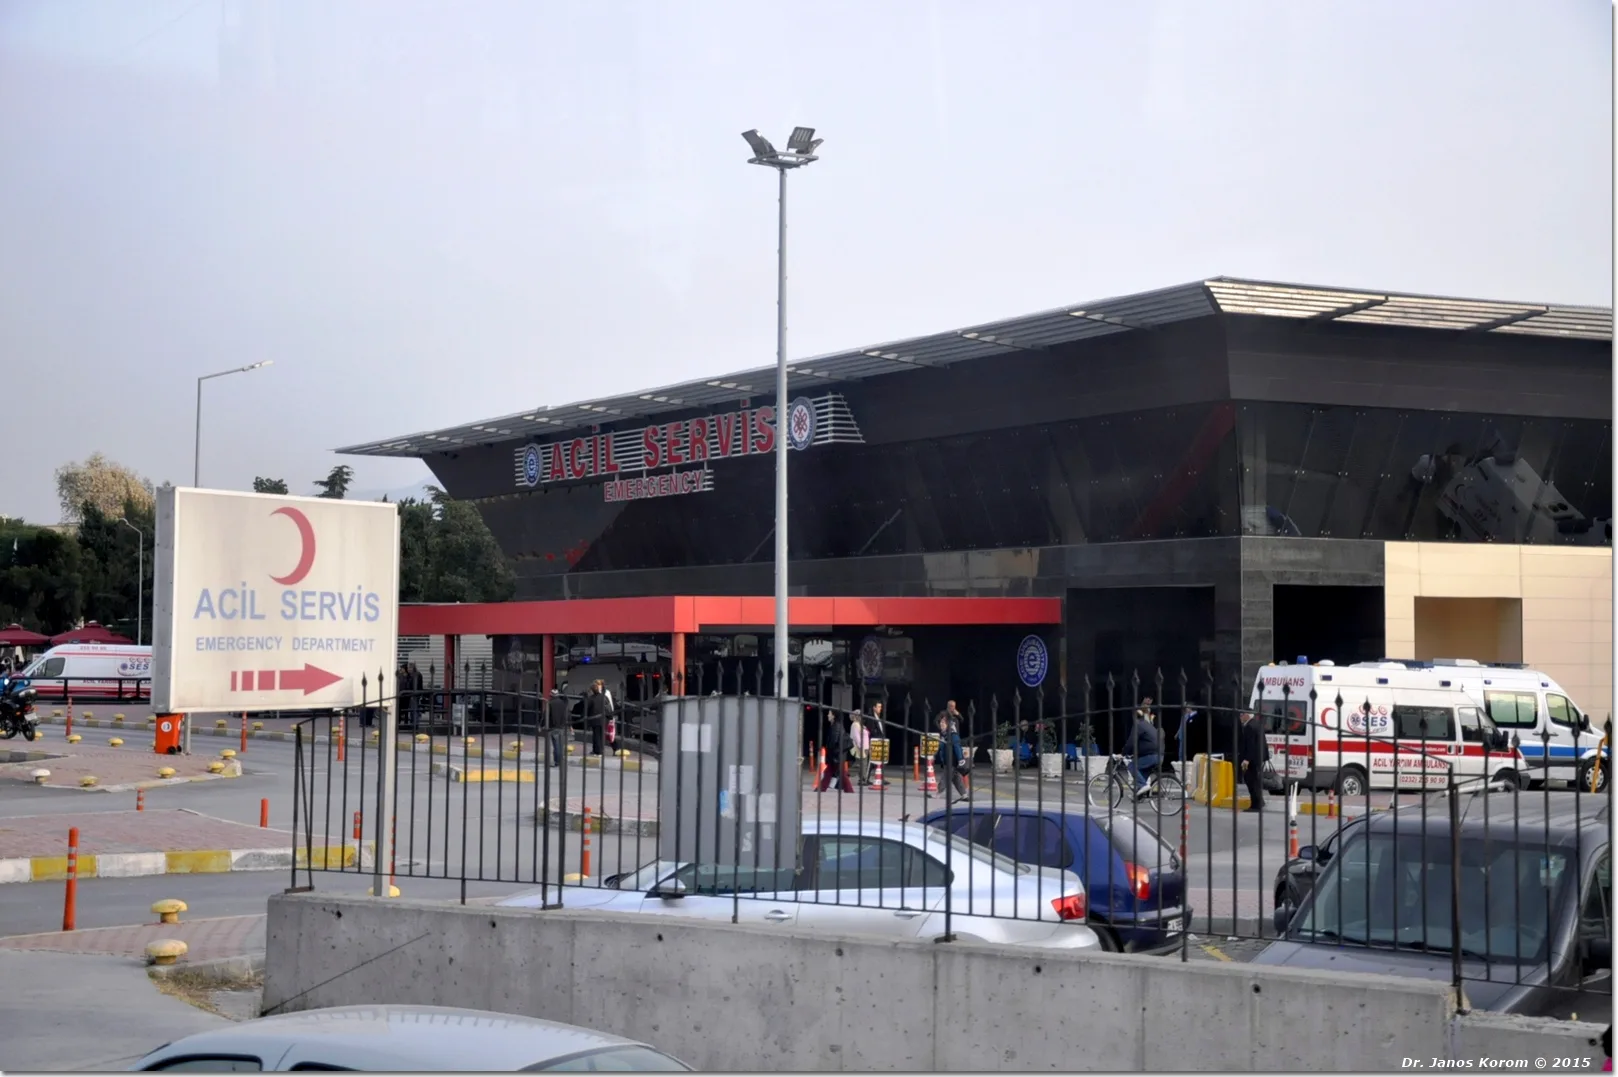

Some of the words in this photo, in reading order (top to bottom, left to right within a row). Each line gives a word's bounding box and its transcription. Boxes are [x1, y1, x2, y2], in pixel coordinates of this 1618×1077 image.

[550, 425, 621, 481] ACİL
[643, 400, 777, 468] SERVİS
[604, 470, 706, 502] EMERGENCY
[193, 581, 266, 620] ACİL
[280, 585, 380, 622] SERVİS
[196, 636, 283, 651] EMERGENCY
[292, 637, 376, 652] DEPARTMENT
[1361, 716, 1388, 727] SES
[1413, 759, 1448, 769] AMULANSI
